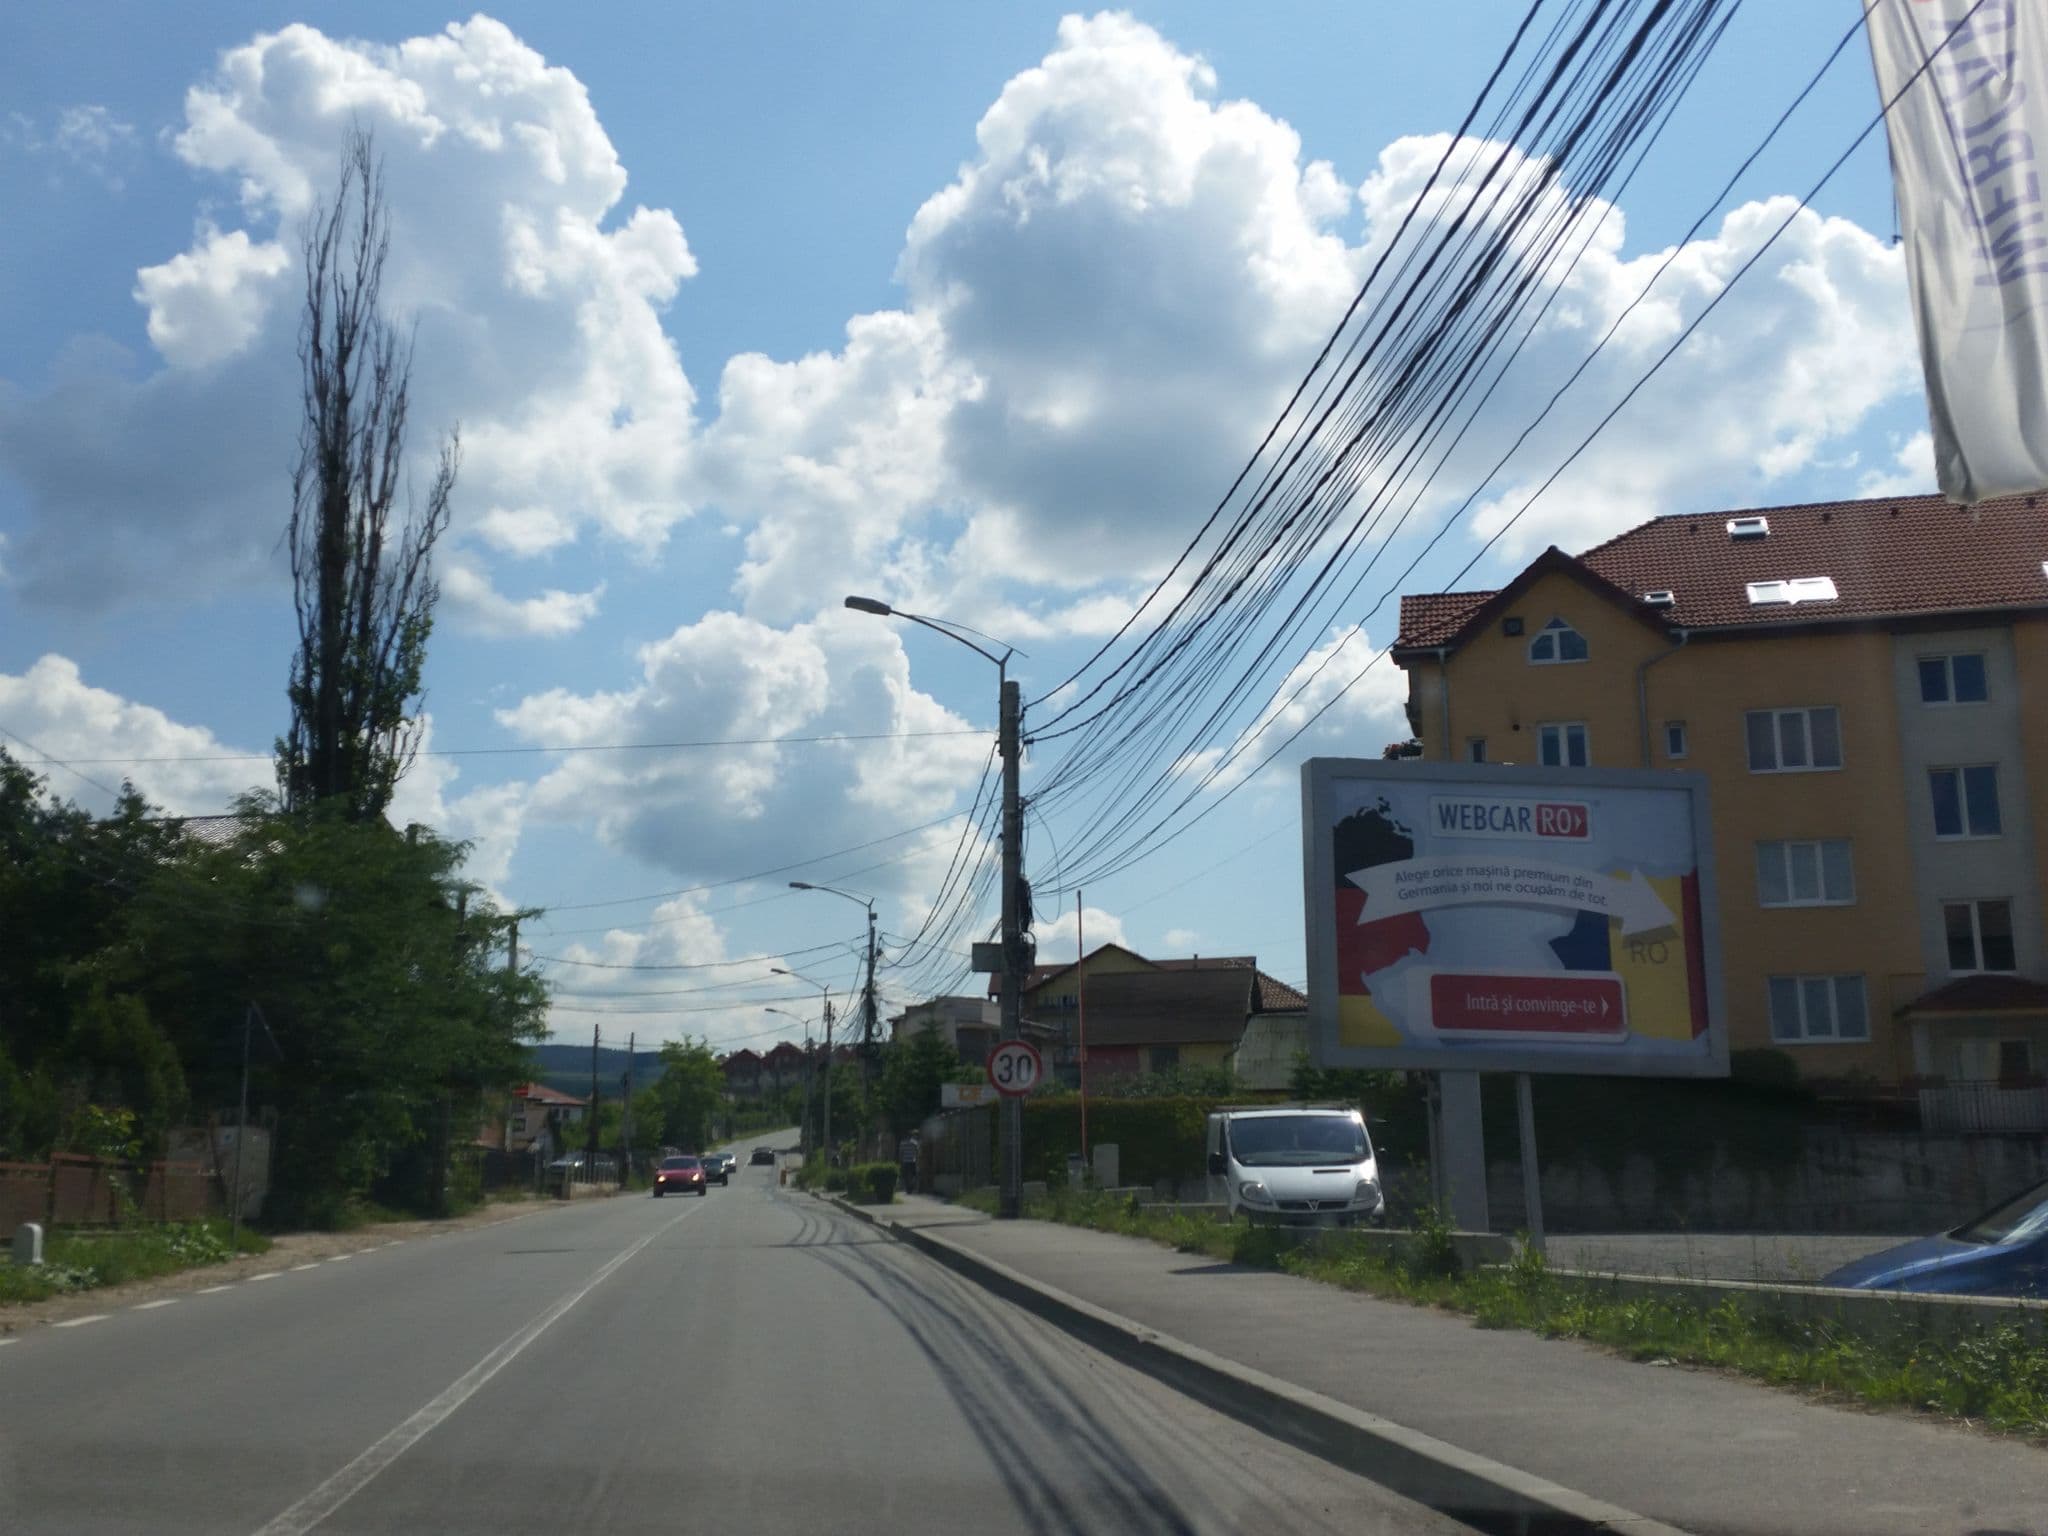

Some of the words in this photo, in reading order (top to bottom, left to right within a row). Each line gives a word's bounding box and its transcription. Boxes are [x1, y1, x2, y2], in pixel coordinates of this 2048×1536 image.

[1438, 803, 1531, 832] WEBCAR
[1541, 807, 1571, 833] RO
[1396, 870, 1430, 884] Alege
[1433, 866, 1463, 879] orice
[1513, 867, 1571, 884] premium
[1574, 874, 1593, 889] din
[1398, 883, 1458, 900] Germania
[1473, 880, 1493, 892] noi
[1496, 883, 1512, 893] ne
[1569, 889, 1585, 901] de
[1631, 939, 1668, 965] RO
[1517, 995, 1597, 1017] convinge-te
[998, 1053, 1032, 1085] 30
